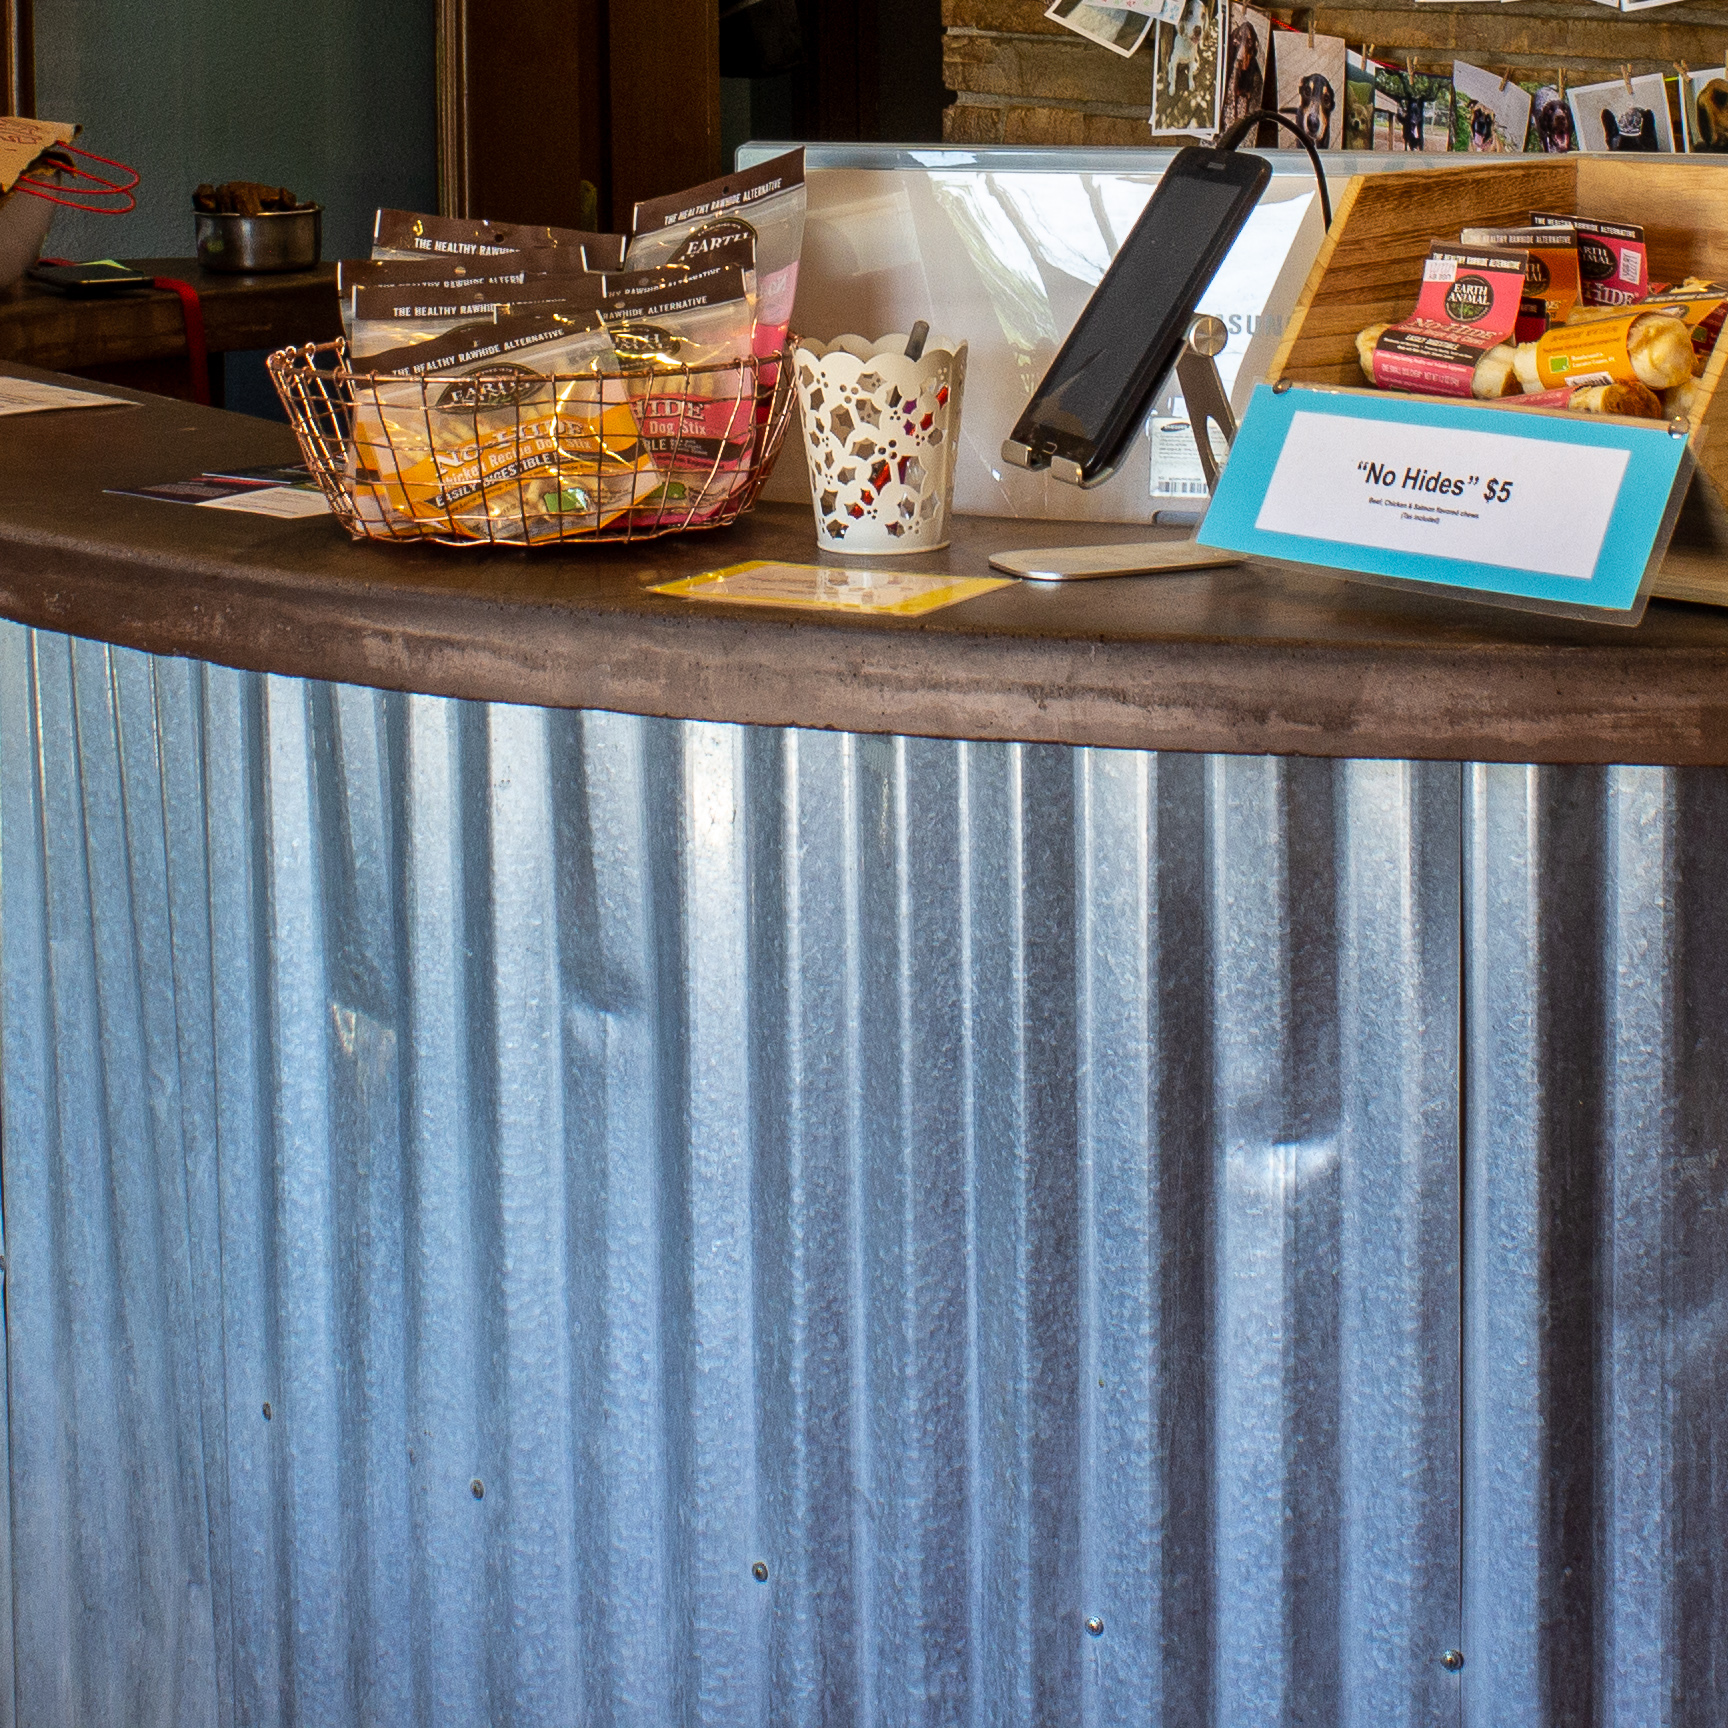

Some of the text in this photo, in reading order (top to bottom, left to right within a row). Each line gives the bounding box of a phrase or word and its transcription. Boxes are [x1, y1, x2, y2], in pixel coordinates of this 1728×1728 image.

[664, 178, 782, 226] THE HEALTHY RAWHIDE ALTERNATIVE
[1454, 283, 1488, 294] EARTH
[647, 295, 707, 315] ALTERNATIVE
[1447, 293, 1490, 305] ANIMAL
[1483, 477, 1513, 503] $5
[1385, 499, 1407, 509] Chicken
